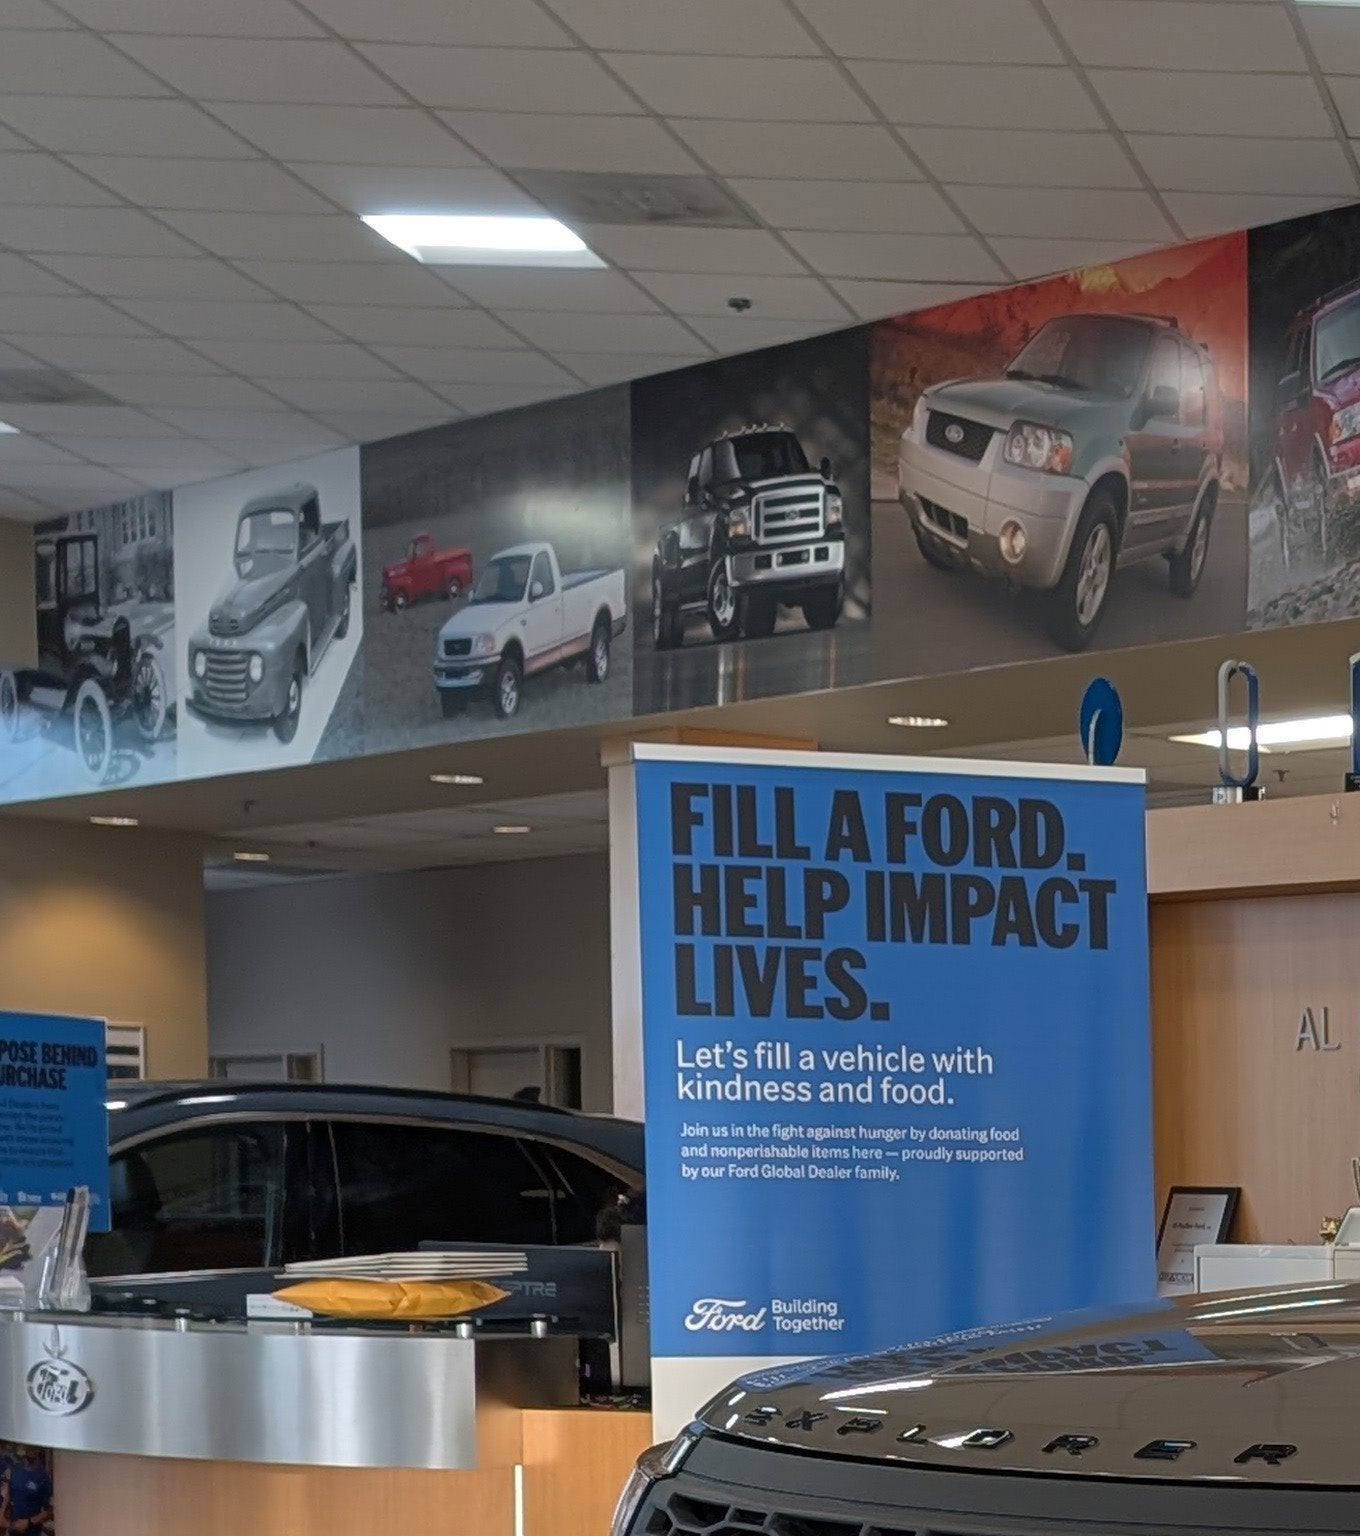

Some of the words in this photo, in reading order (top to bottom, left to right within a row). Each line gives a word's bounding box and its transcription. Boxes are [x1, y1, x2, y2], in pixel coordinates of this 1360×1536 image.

[670, 781, 811, 861] FILL
[825, 789, 872, 864] A
[884, 791, 1087, 872] FORD.
[672, 862, 851, 940] HELP
[865, 869, 1117, 950] IMPACT
[674, 942, 891, 1021] LIVES.
[1296, 1005, 1343, 1051] AL
[754, 1041, 791, 1071] fill
[799, 1048, 816, 1071] a
[821, 1044, 925, 1073] vehicle
[931, 1046, 994, 1075] with
[677, 1072, 812, 1102] kindness
[818, 1075, 873, 1103] and
[880, 1076, 955, 1105] food.
[680, 1122, 709, 1138] Join
[712, 1125, 729, 1138] us
[731, 1123, 745, 1138] in
[747, 1123, 770, 1138] the
[772, 1123, 805, 1141] fight
[806, 1124, 857, 1141] against
[859, 1125, 907, 1142] hunger
[910, 1126, 926, 1142] by
[929, 1126, 988, 1144] donating
[990, 1126, 1020, 1142] food
[681, 1143, 708, 1158] and
[710, 1144, 809, 1160] nonperishable
[812, 1144, 850, 1159] items
[852, 1145, 883, 1159] here
[902, 1146, 953, 1163] proudly
[955, 1147, 1024, 1163] supported
[681, 1163, 699, 1180] by
[701, 1167, 726, 1178] our
[728, 1163, 759, 1179] Ford
[761, 1163, 805, 1179] Global
[808, 1164, 852, 1179] Dealer
[684, 1298, 768, 1332] Ford
[771, 1299, 838, 1317] Building
[772, 1316, 845, 1334] Together
[742, 1405, 1298, 1466] EXPLORER
